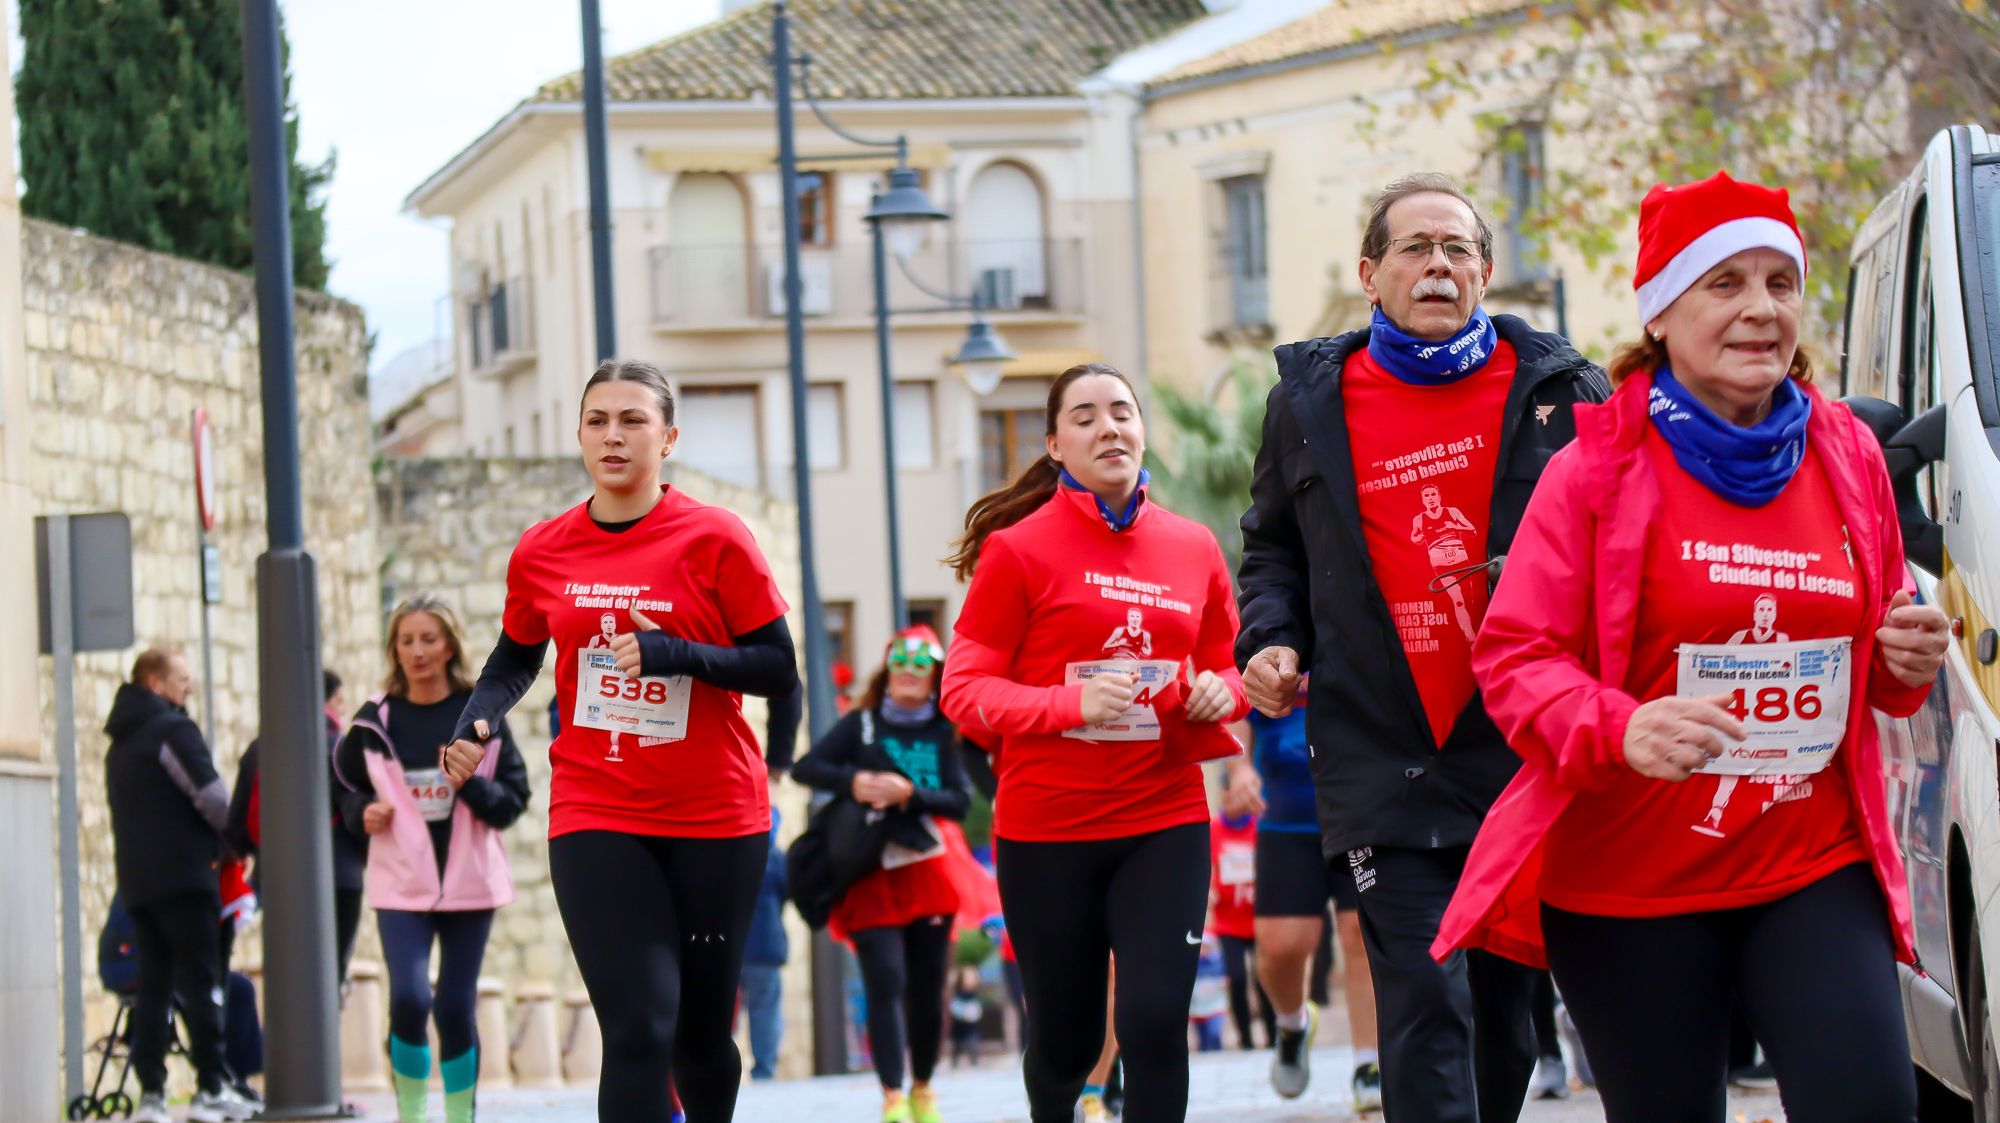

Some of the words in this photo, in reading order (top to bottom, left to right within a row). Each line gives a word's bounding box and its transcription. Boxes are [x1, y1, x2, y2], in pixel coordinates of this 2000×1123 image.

[1681, 540, 1692, 560] I
[1694, 541, 1730, 563] San
[1731, 543, 1808, 570] Silvestre
[564, 583, 571, 595] I
[570, 583, 591, 595] San
[591, 583, 640, 597] Silvestre
[1084, 572, 1091, 584] I
[1092, 573, 1114, 587] San
[1115, 575, 1162, 595] Silvestre
[1708, 563, 1772, 587] Ciudad
[1773, 569, 1796, 590] de
[1797, 571, 1854, 599] Lucena
[574, 595, 614, 609] Ciudad
[614, 597, 629, 609] de
[1100, 587, 1139, 604] Ciudad
[1140, 593, 1154, 607] de
[1155, 596, 1191, 615] Lucena
[1698, 669, 1737, 680] Ciudad
[1738, 670, 1752, 680] de
[1754, 670, 1790, 680] Lucena
[1700, 658, 1720, 669] San
[1722, 658, 1769, 670] Silvestre
[599, 674, 667, 705] 538
[1727, 684, 1822, 723] 486
